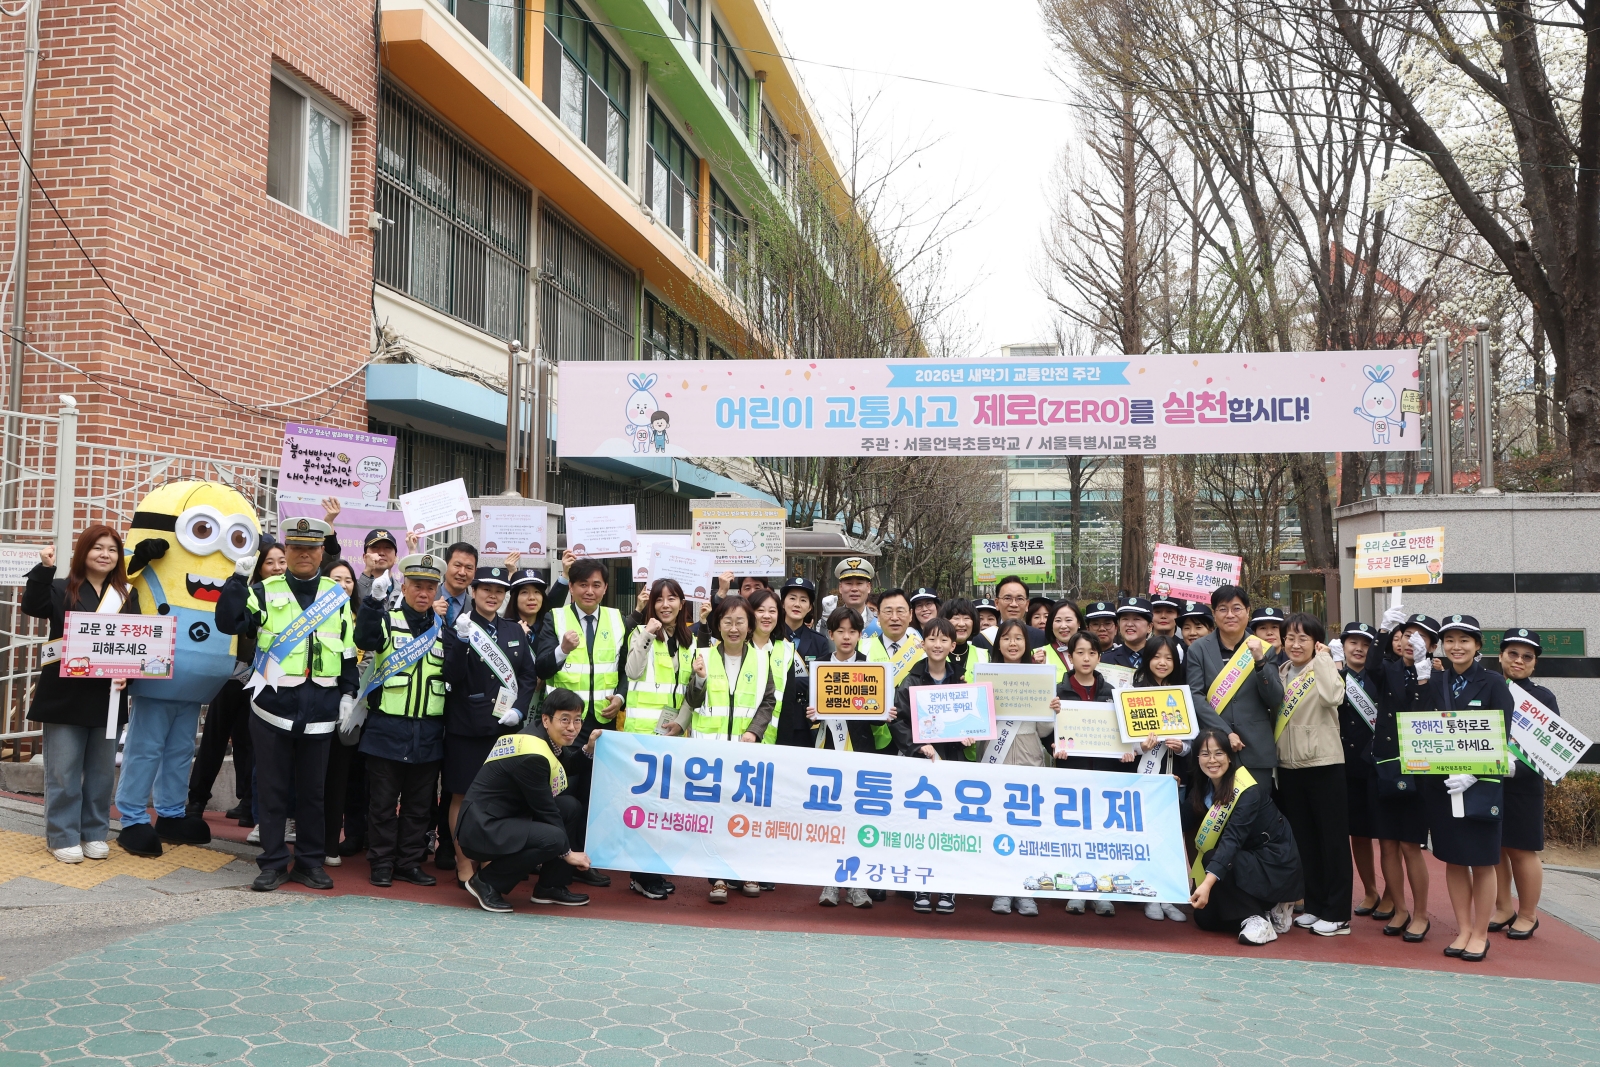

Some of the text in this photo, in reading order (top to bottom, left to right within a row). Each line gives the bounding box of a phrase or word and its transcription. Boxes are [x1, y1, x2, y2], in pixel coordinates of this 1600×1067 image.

[915, 367, 1101, 382] 2026년 새학기 교통안전 주간
[716, 391, 1309, 429] 어린이 교통사고 제로(ZERO)를 실천합시다!
[861, 437, 889, 452] 주관
[904, 436, 1020, 452] 서울언북초등학교
[1038, 435, 1157, 451] 서울특별시교육청
[290, 443, 336, 461] 붕어빵엔
[983, 540, 1044, 553] 정해진 통학로로
[1364, 536, 1435, 553] 우리 손으로 안전한
[982, 555, 1045, 568] 안전등교 하세요.
[1162, 552, 1233, 572] 안전한 등교를 위해
[1367, 554, 1429, 570] 등굣길 만들어요.
[1158, 567, 1175, 579] 우리
[1177, 570, 1193, 583] 모두
[305, 590, 337, 618] 교통사고는
[78, 622, 163, 638] 교문 앞 주정차를
[92, 642, 147, 656] 피해주세요
[824, 672, 878, 684] 스쿨존 30km,
[1216, 668, 1241, 697] 교통안전
[825, 685, 877, 695] 우리 아이들의
[929, 690, 969, 703] 걸어서 학교로!
[825, 697, 862, 708] 생명선 30
[928, 701, 973, 714] 건강에도 좋아요!
[1127, 696, 1155, 708] 멈춰요!
[1129, 708, 1158, 719] 살펴요!
[1132, 720, 1161, 731] 건너요!
[1411, 719, 1491, 734] 정해진 통학로로
[1520, 700, 1585, 753] 걸어서 등교하면
[1411, 739, 1494, 753] 안전등교 하세요.
[1533, 727, 1551, 747] 마음
[1551, 742, 1575, 764] 튼튼!
[630, 753, 1144, 832] 기업체 교통수요관리제
[661, 812, 714, 834] 신청해요!
[765, 819, 803, 841] 혜택이
[805, 822, 846, 845] 있어요!
[904, 833, 925, 851] 이상
[928, 832, 982, 854] 이행해요!
[1018, 840, 1082, 859] 십퍼센트까지
[1085, 840, 1151, 862] 감면해줘요!
[866, 863, 935, 885] 강남구
